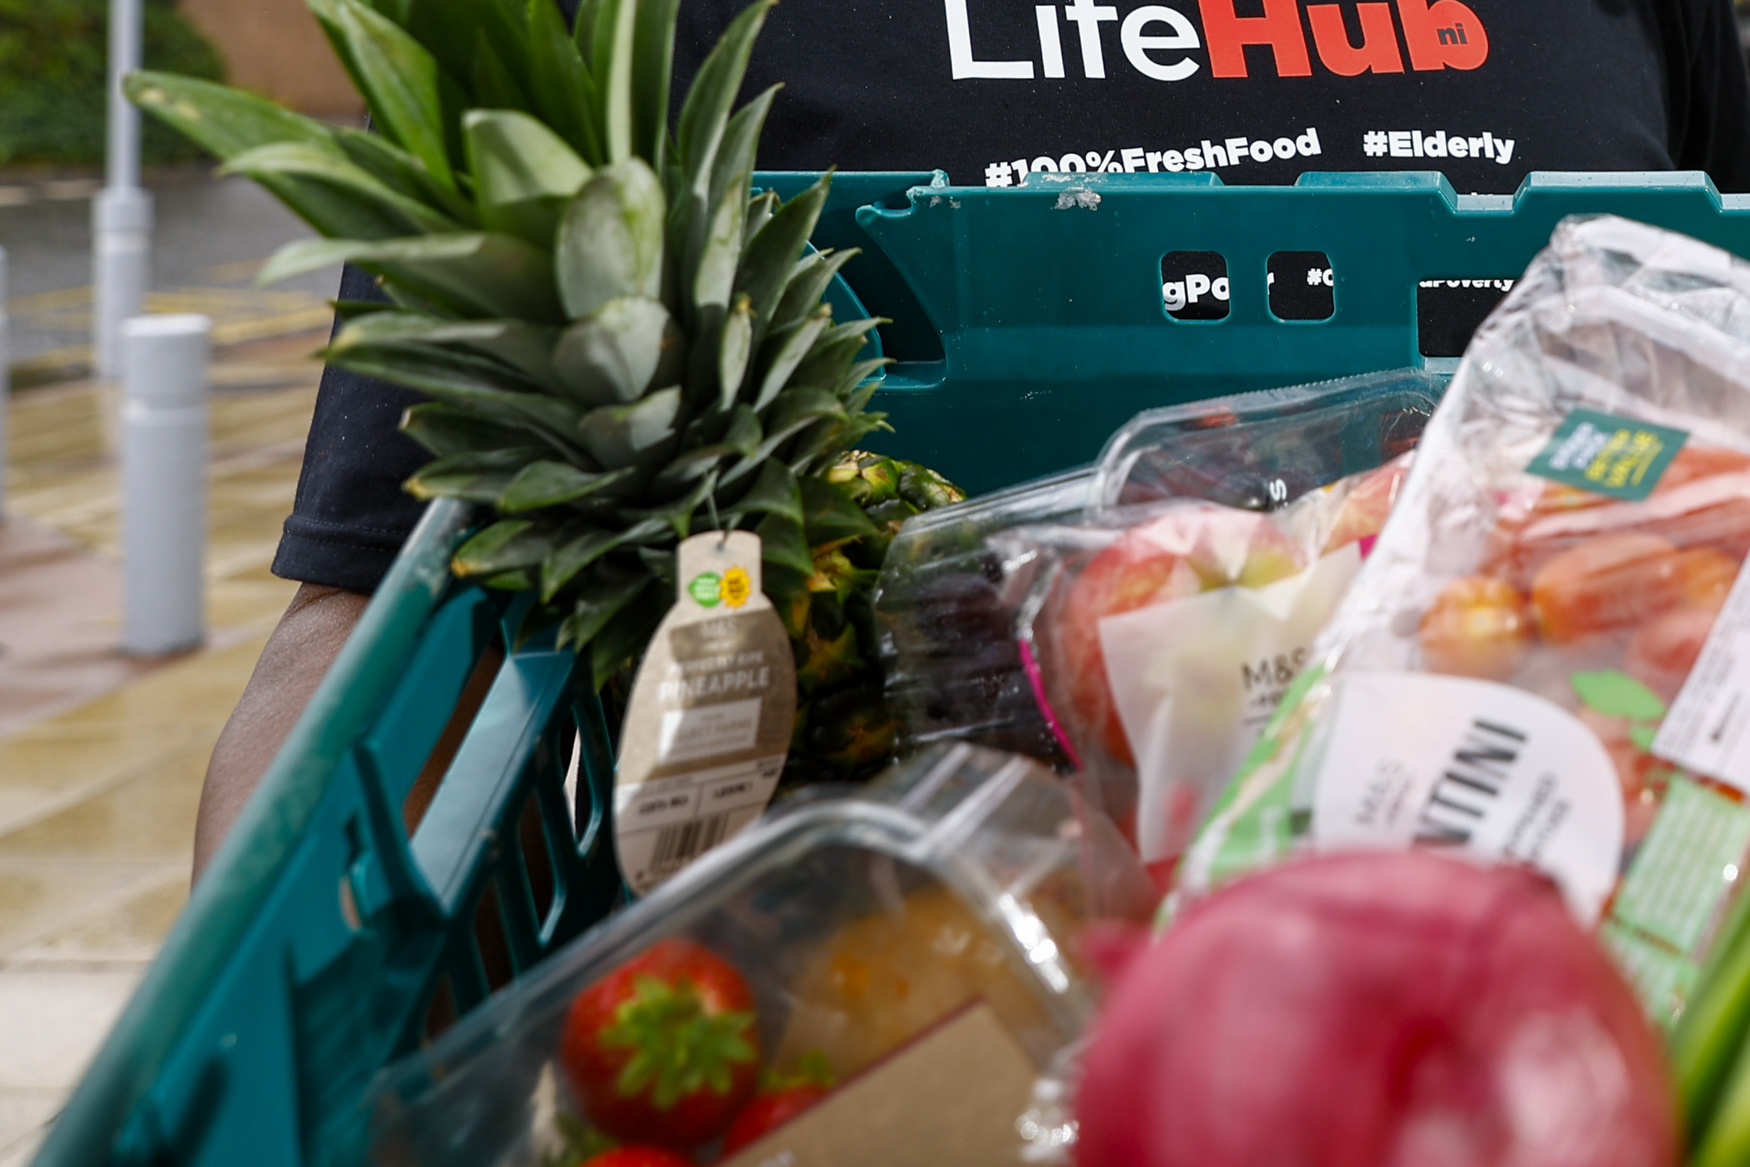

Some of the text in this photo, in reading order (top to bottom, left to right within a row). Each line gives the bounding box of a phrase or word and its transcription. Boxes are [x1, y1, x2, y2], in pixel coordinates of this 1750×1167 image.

[1437, 22, 1468, 45] ni
[1363, 130, 1515, 165] #Elderly
[657, 667, 769, 702] PINEAPPLE
[1410, 717, 1528, 848] NTINI
